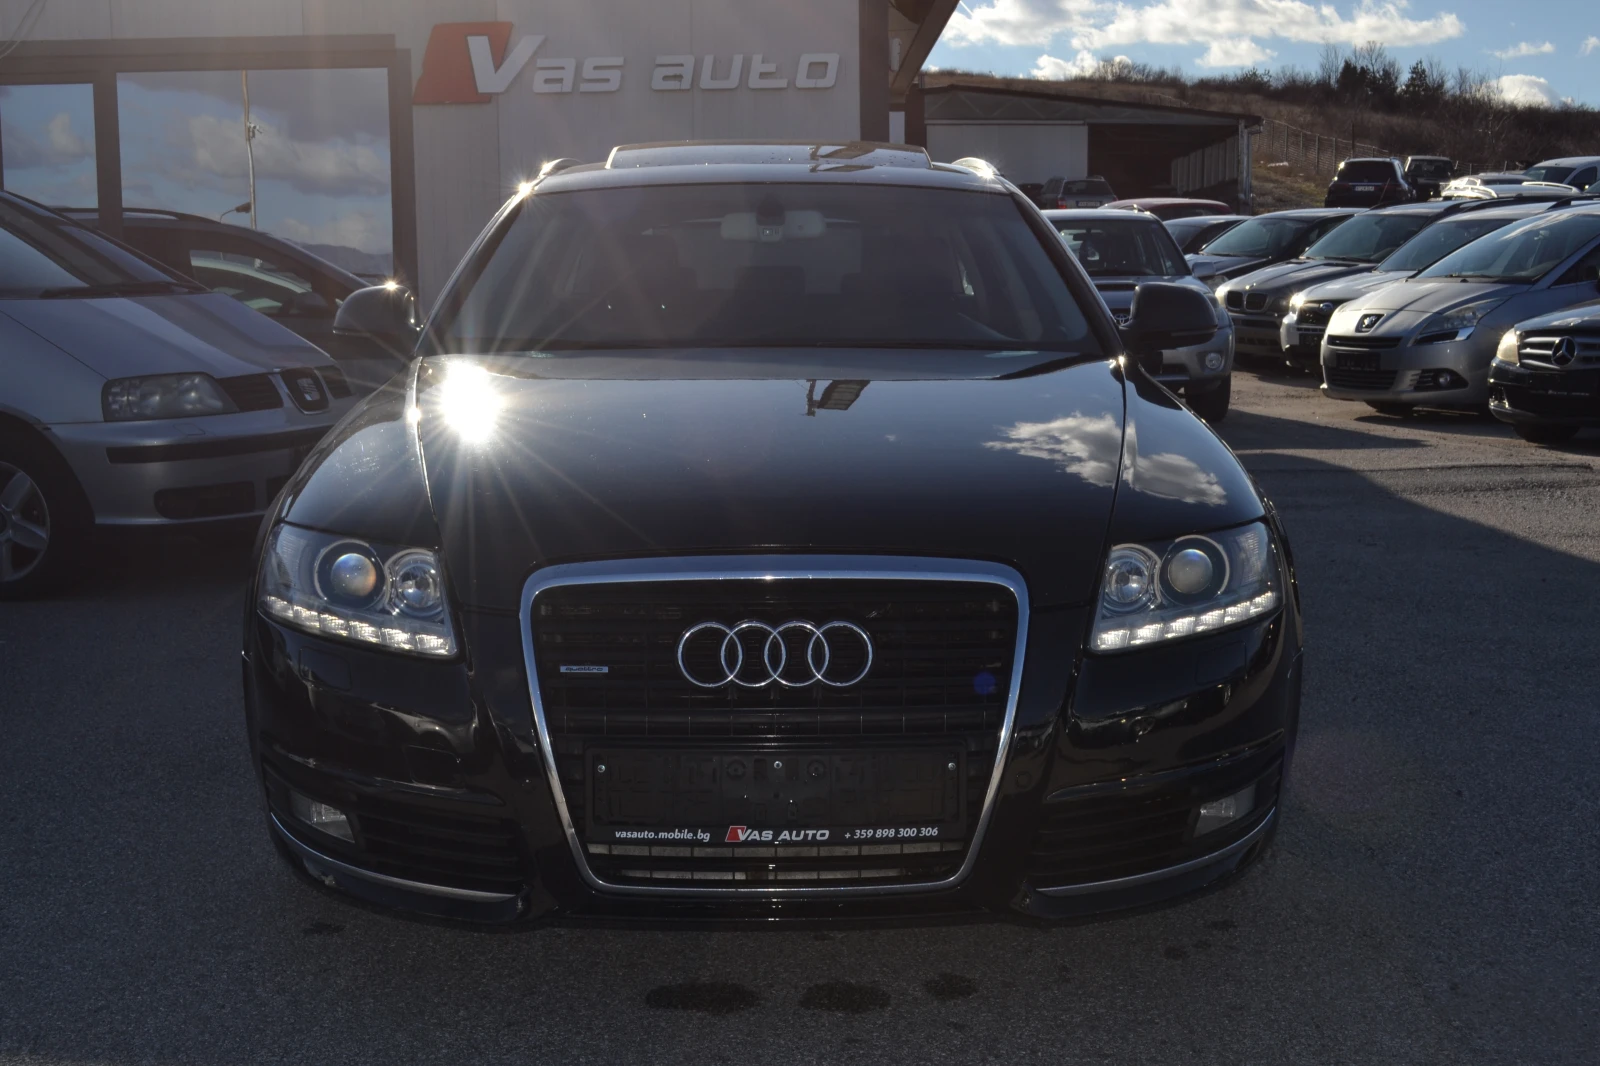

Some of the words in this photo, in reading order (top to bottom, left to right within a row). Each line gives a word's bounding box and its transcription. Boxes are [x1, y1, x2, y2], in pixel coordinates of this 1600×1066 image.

[466, 35, 625, 94] Vas
[651, 52, 841, 91] auto
[615, 829, 711, 842] vasauto.mobile.bg
[737, 829, 774, 841] VAS
[777, 829, 830, 841] AUTO
[875, 828, 895, 838] 898
[897, 827, 917, 838] 300
[919, 827, 939, 837] 306
